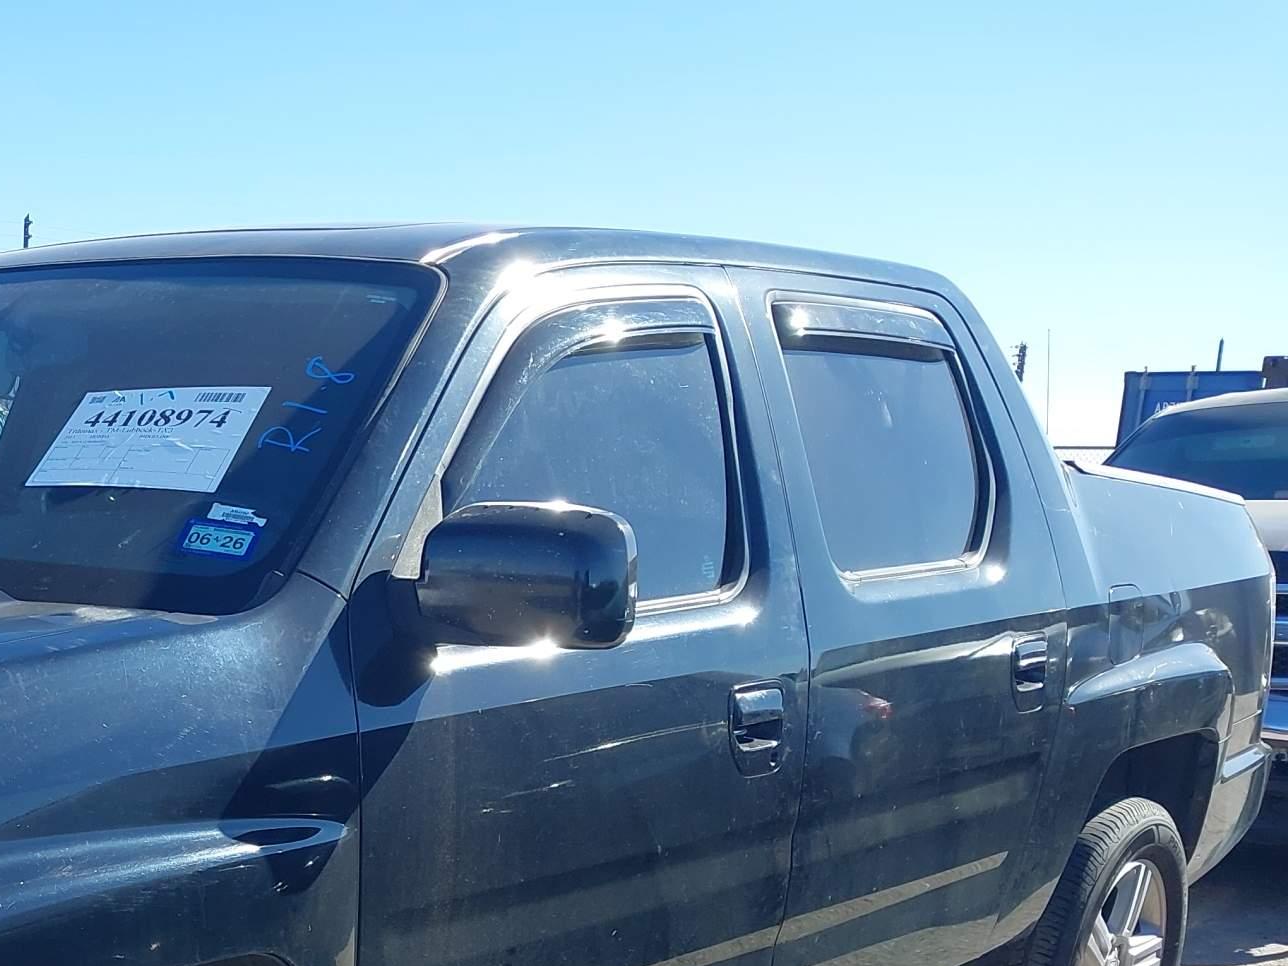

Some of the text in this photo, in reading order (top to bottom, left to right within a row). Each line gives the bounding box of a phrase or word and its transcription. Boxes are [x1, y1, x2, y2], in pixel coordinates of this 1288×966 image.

[84, 408, 229, 428] 44108974
[187, 531, 246, 550] 06 26
